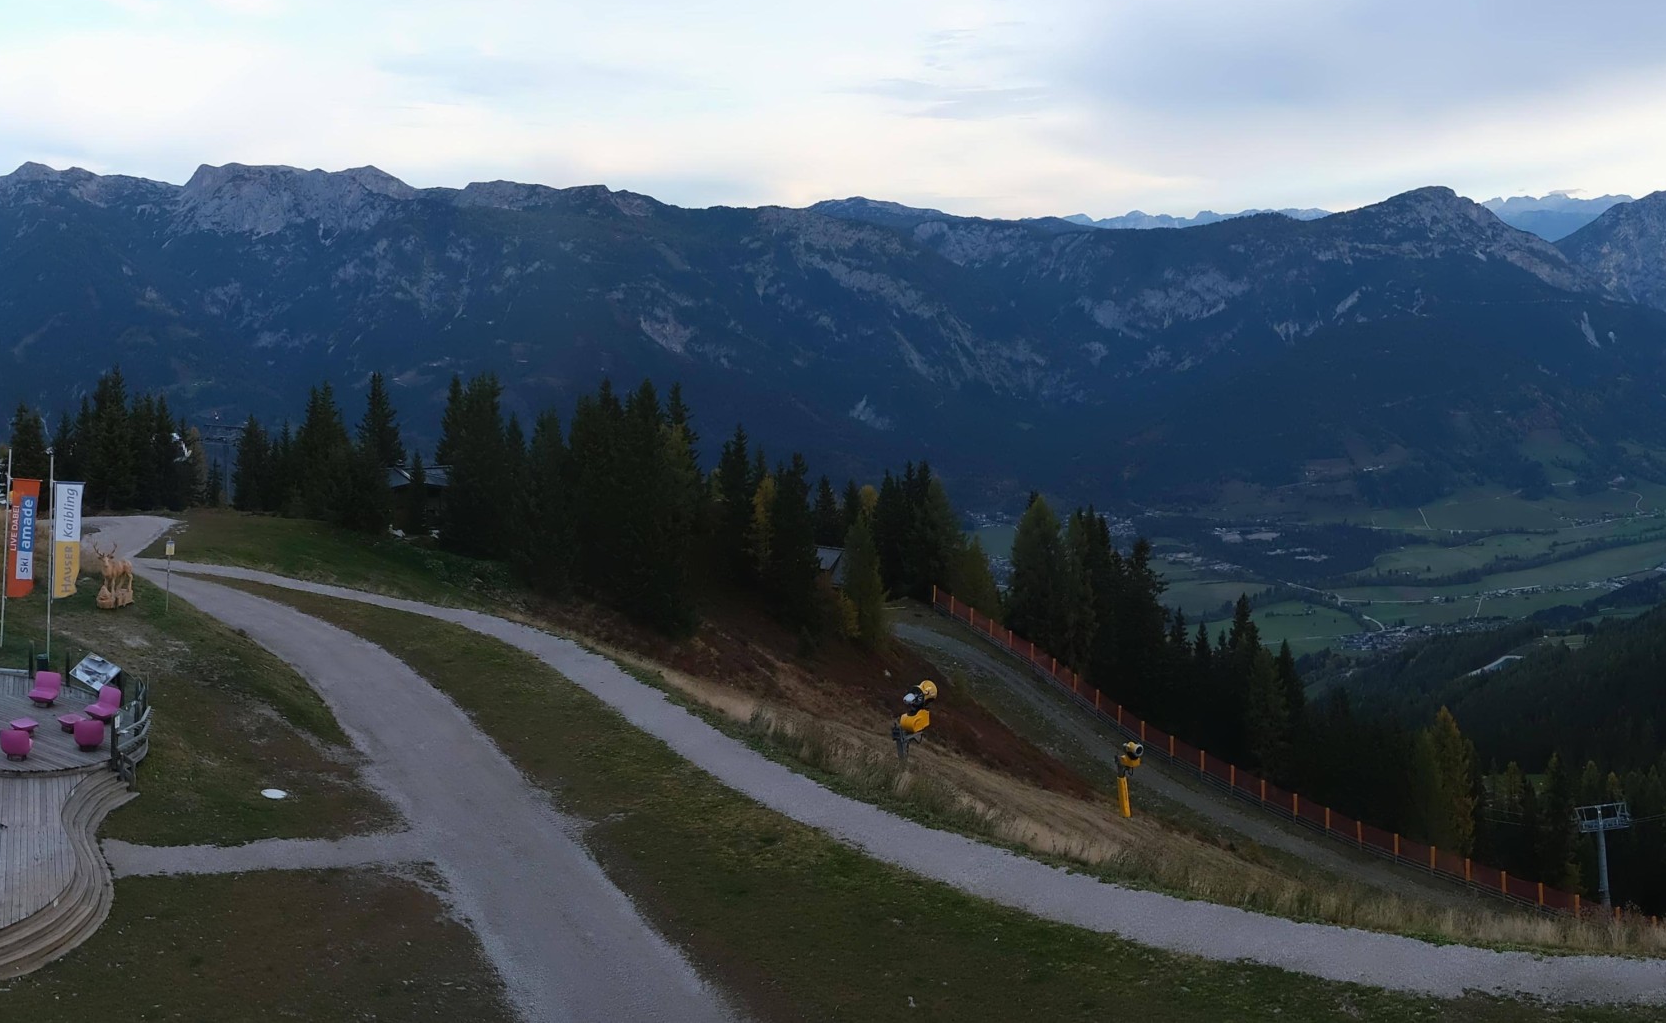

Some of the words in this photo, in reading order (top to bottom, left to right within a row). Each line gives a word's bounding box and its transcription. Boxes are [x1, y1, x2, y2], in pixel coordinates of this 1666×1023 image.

[11, 506, 20, 531] DABEI
[64, 488, 78, 538] Kaibling
[20, 558, 29, 573] Ski
[62, 546, 73, 592] HAUSER
